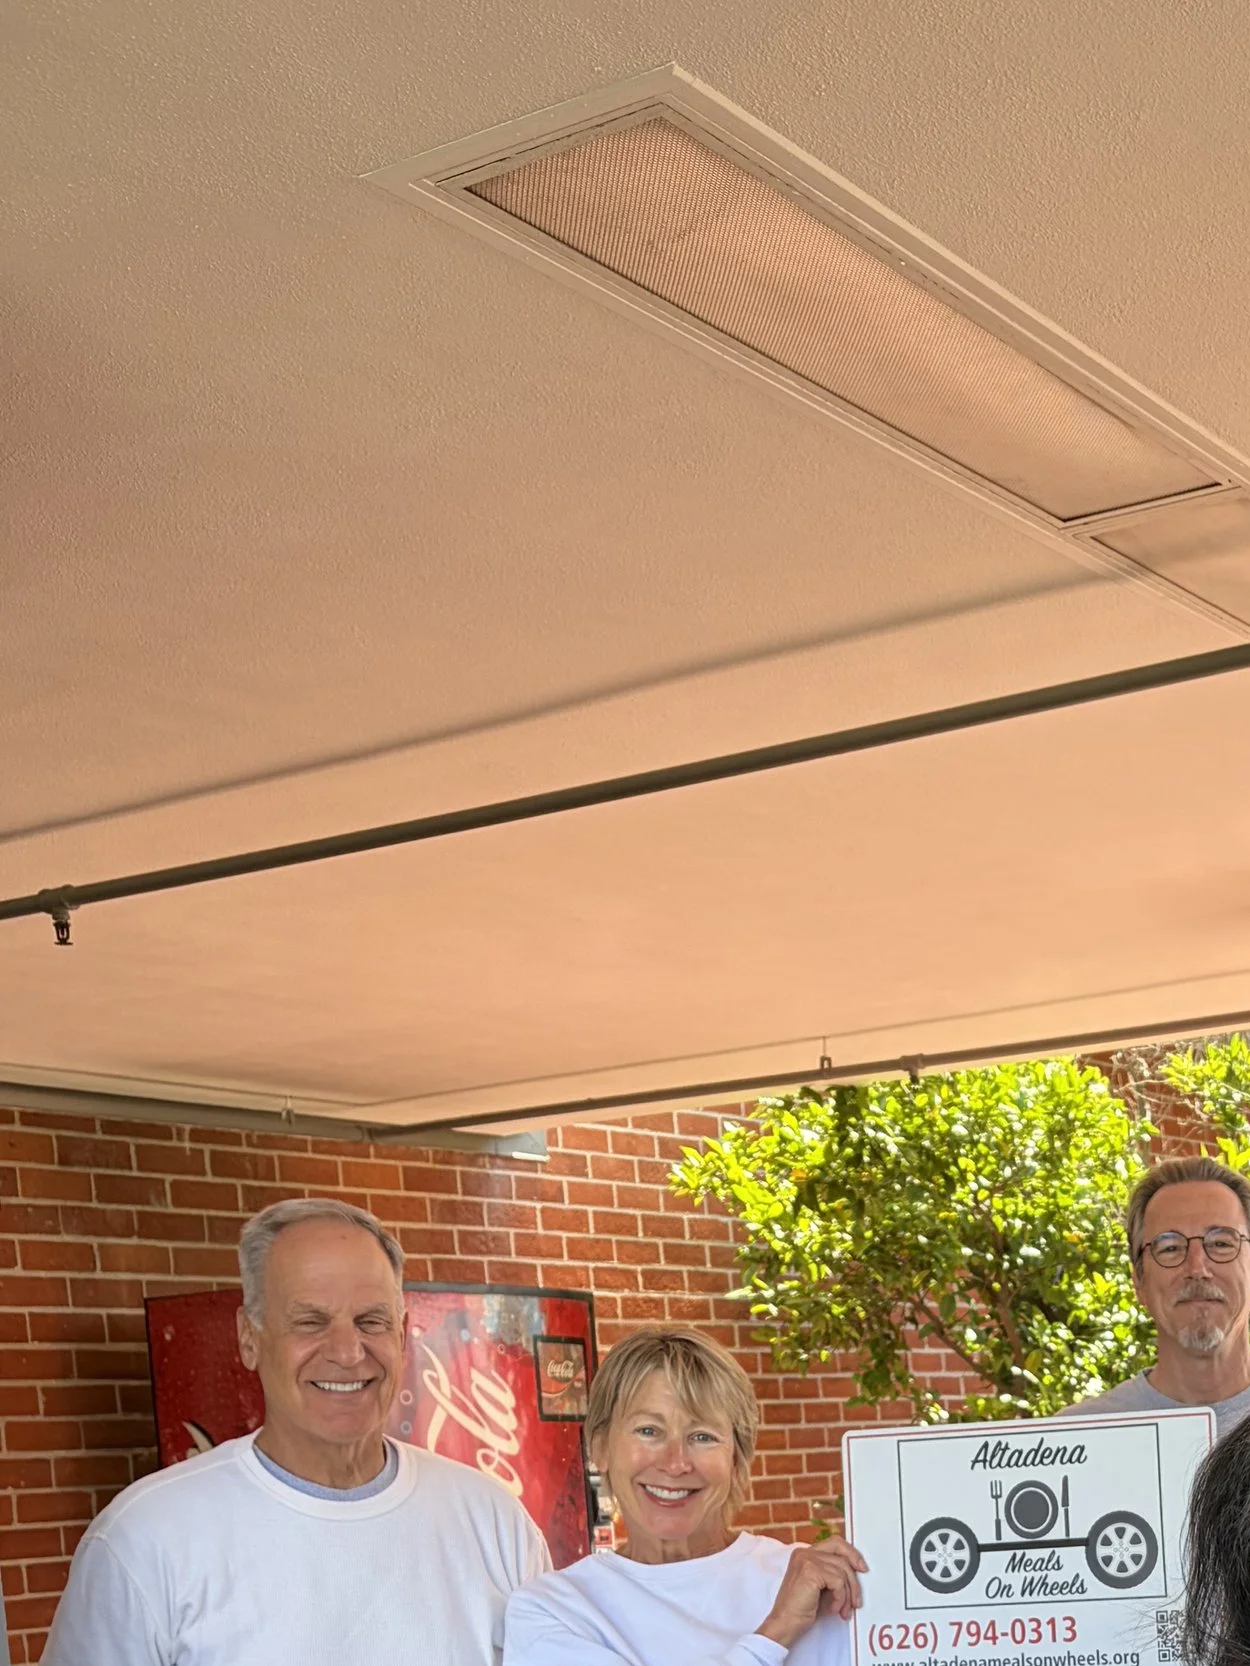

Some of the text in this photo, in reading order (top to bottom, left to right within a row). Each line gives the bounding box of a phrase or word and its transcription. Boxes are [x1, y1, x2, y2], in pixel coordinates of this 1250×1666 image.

[971, 1437, 1087, 1470] Altadena
[1005, 1550, 1063, 1574] Meals
[985, 1573, 1087, 1599] On Wheels
[868, 1616, 1077, 1656] (626) 794-0313
